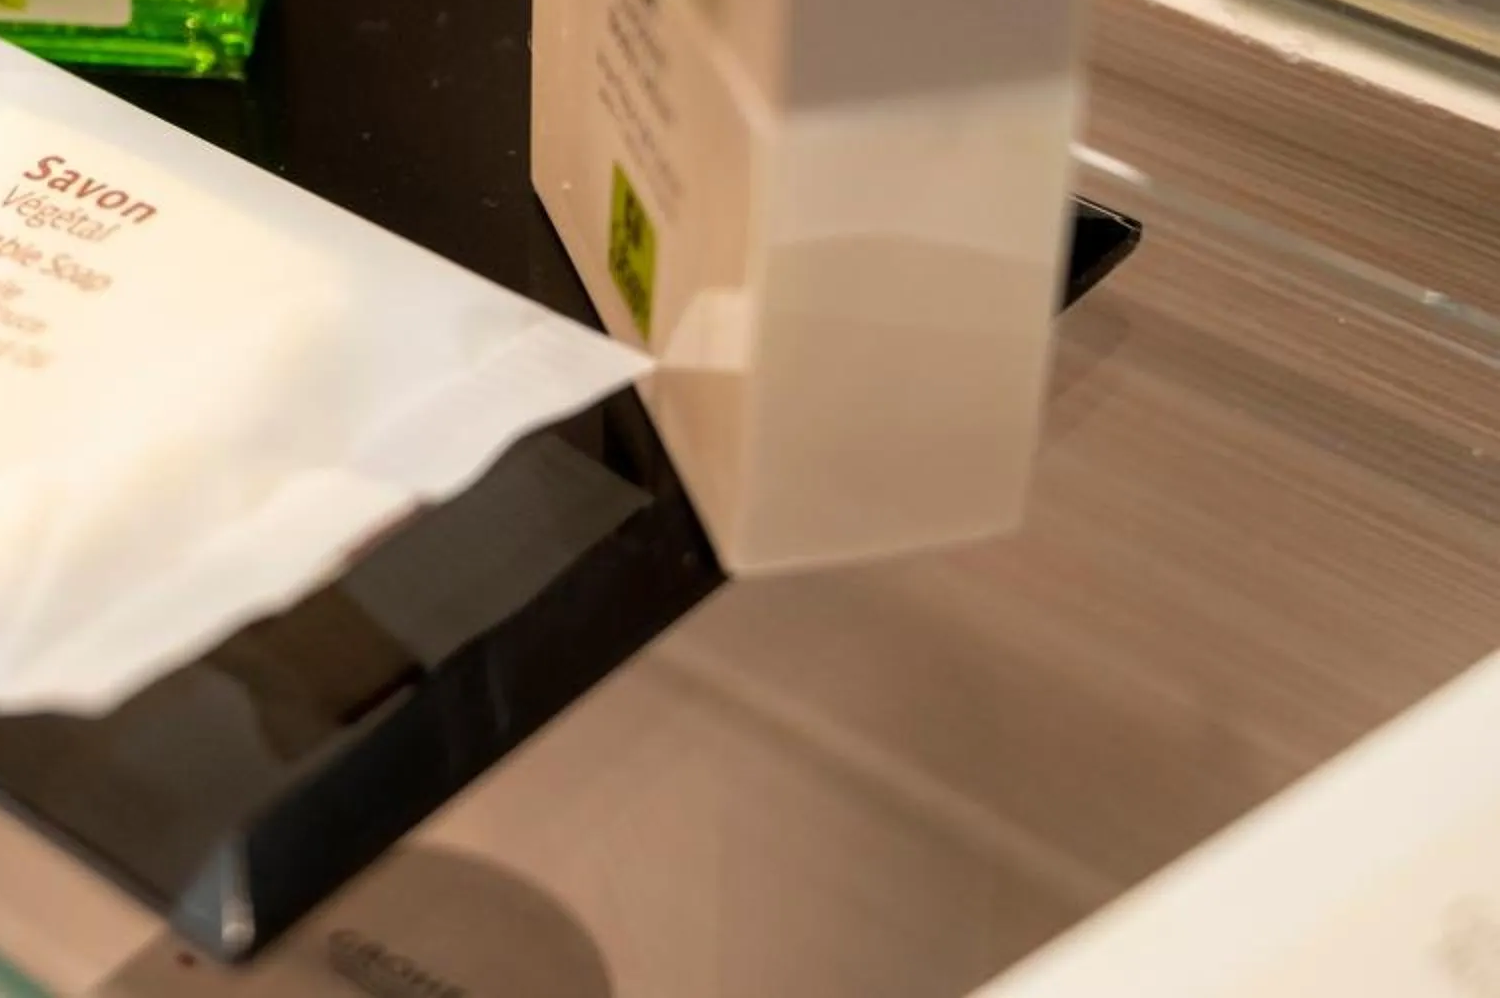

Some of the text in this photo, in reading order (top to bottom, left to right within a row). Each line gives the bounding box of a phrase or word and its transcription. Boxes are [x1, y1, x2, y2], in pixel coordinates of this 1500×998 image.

[1, 184, 121, 242] Végétal
[22, 154, 160, 224] Savon
[39, 252, 114, 294] Soap
